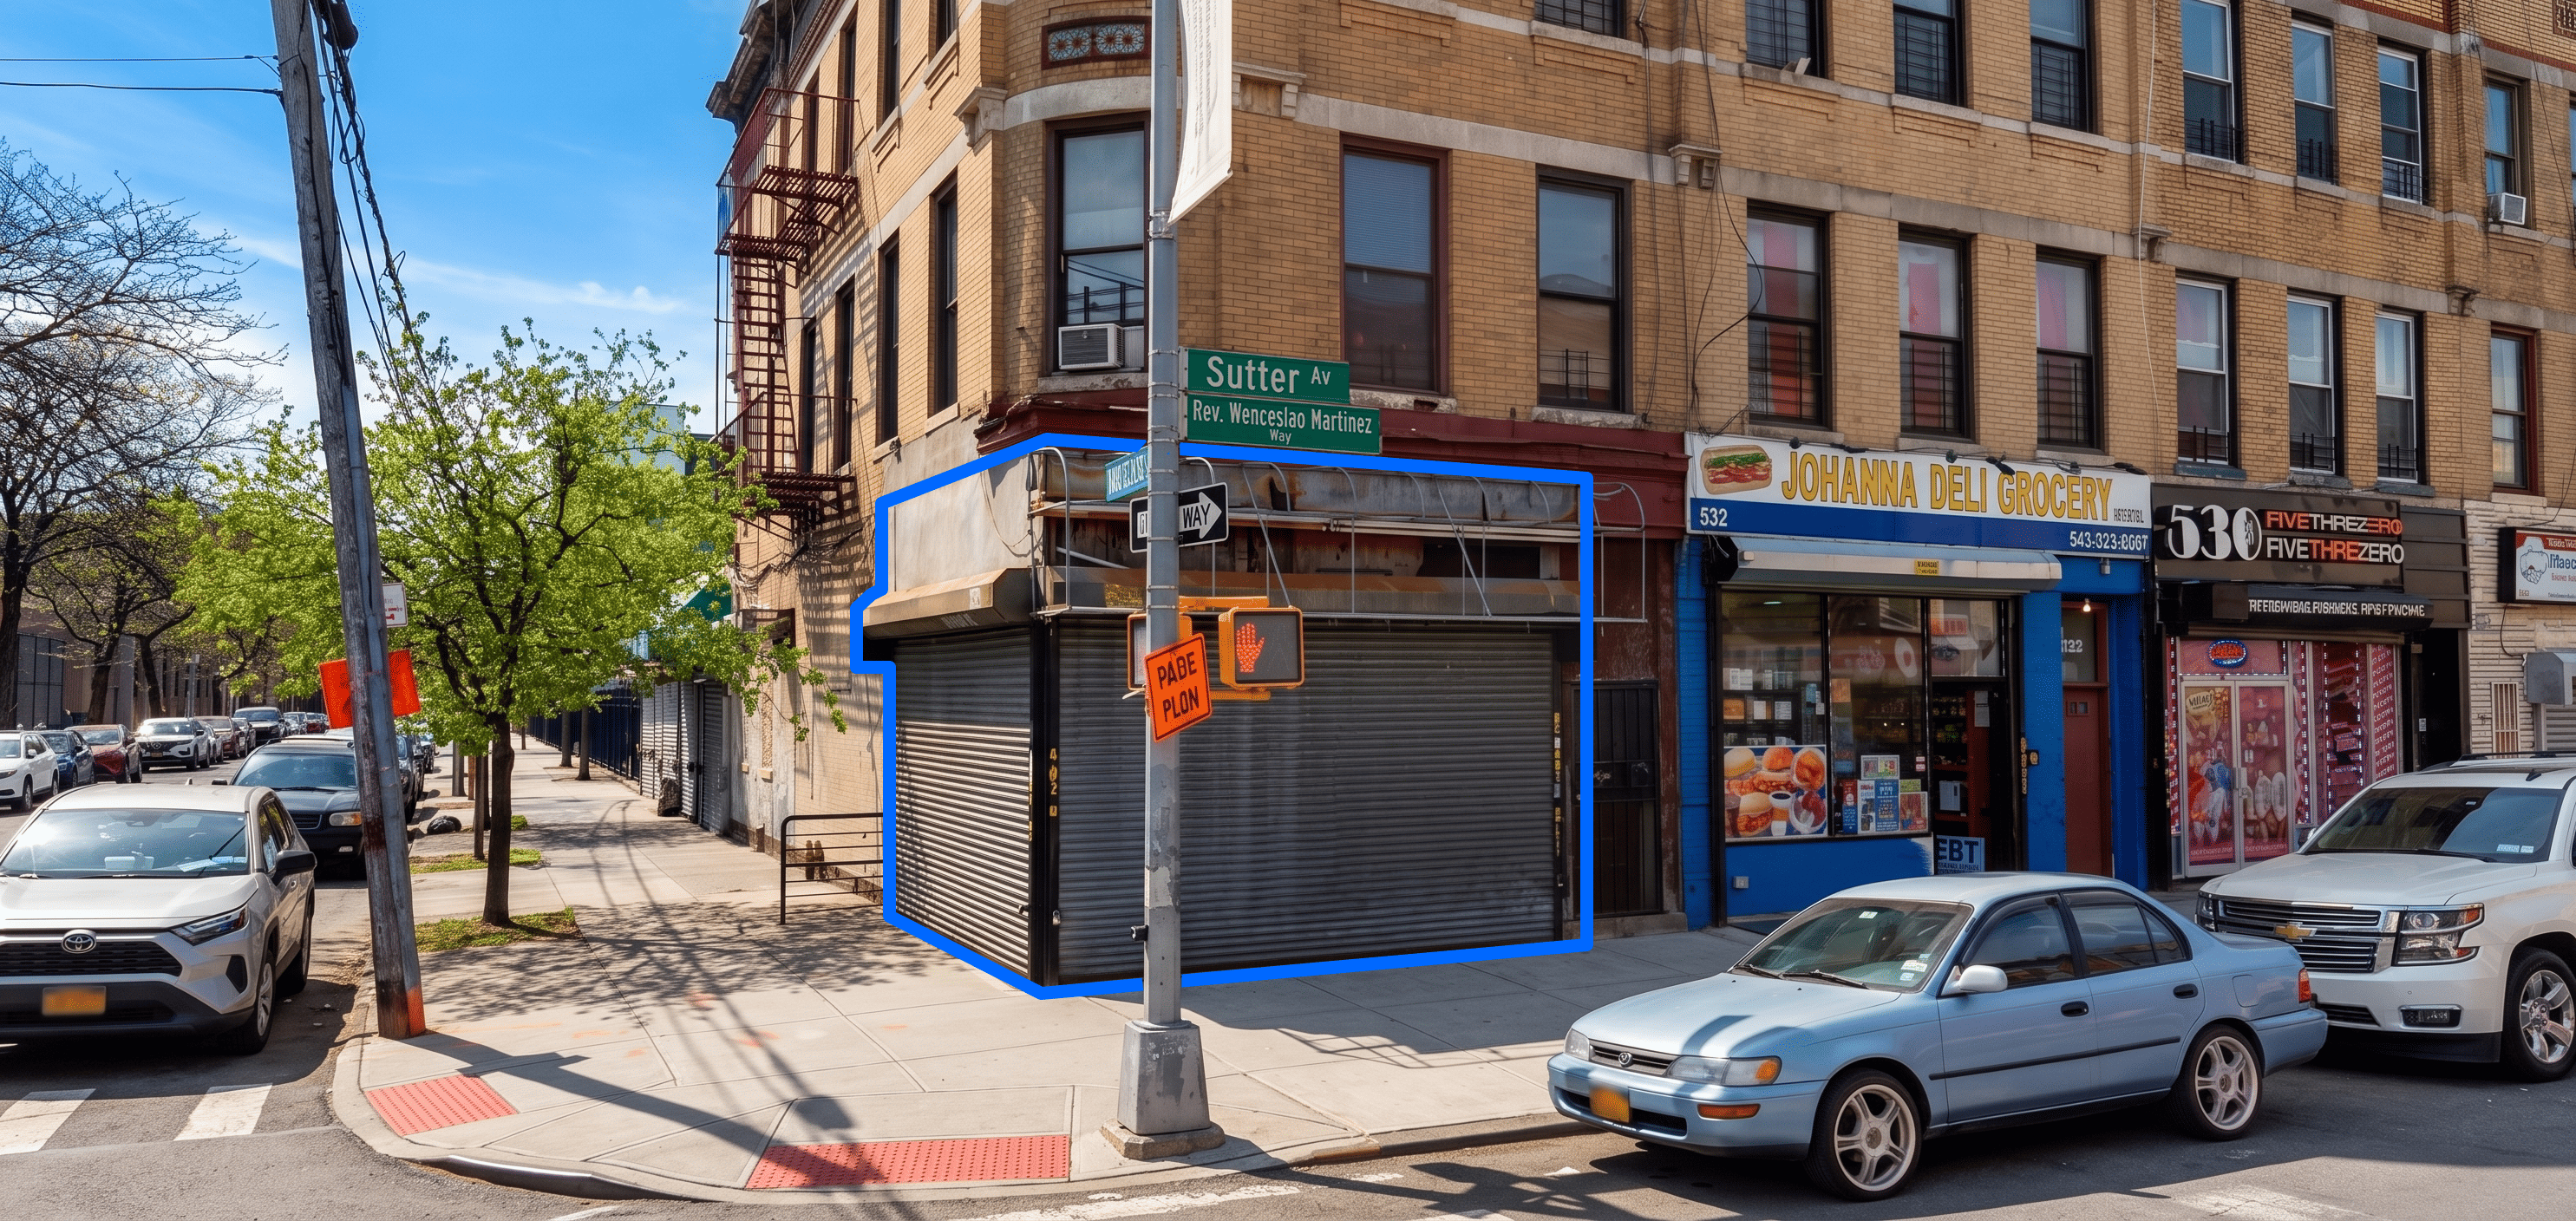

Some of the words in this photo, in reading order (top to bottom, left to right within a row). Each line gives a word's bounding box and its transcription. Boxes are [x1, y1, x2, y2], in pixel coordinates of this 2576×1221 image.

[1206, 356, 1300, 394] Sutter
[1311, 366, 1331, 386] Av
[1193, 399, 1224, 423] Rev.
[1229, 402, 1306, 429] Wenceslao
[1311, 408, 1373, 434] Martinez
[1269, 428, 1292, 446] Way
[1782, 451, 1919, 509] JOHANNA
[1930, 463, 1988, 513] DELI
[1997, 470, 2114, 521] GROCERY
[1182, 502, 1212, 529] WAY
[1700, 506, 1728, 527] 532
[2167, 504, 2262, 561] 530
[1162, 685, 1200, 722] PLON
[1934, 838, 1979, 864] EBT
